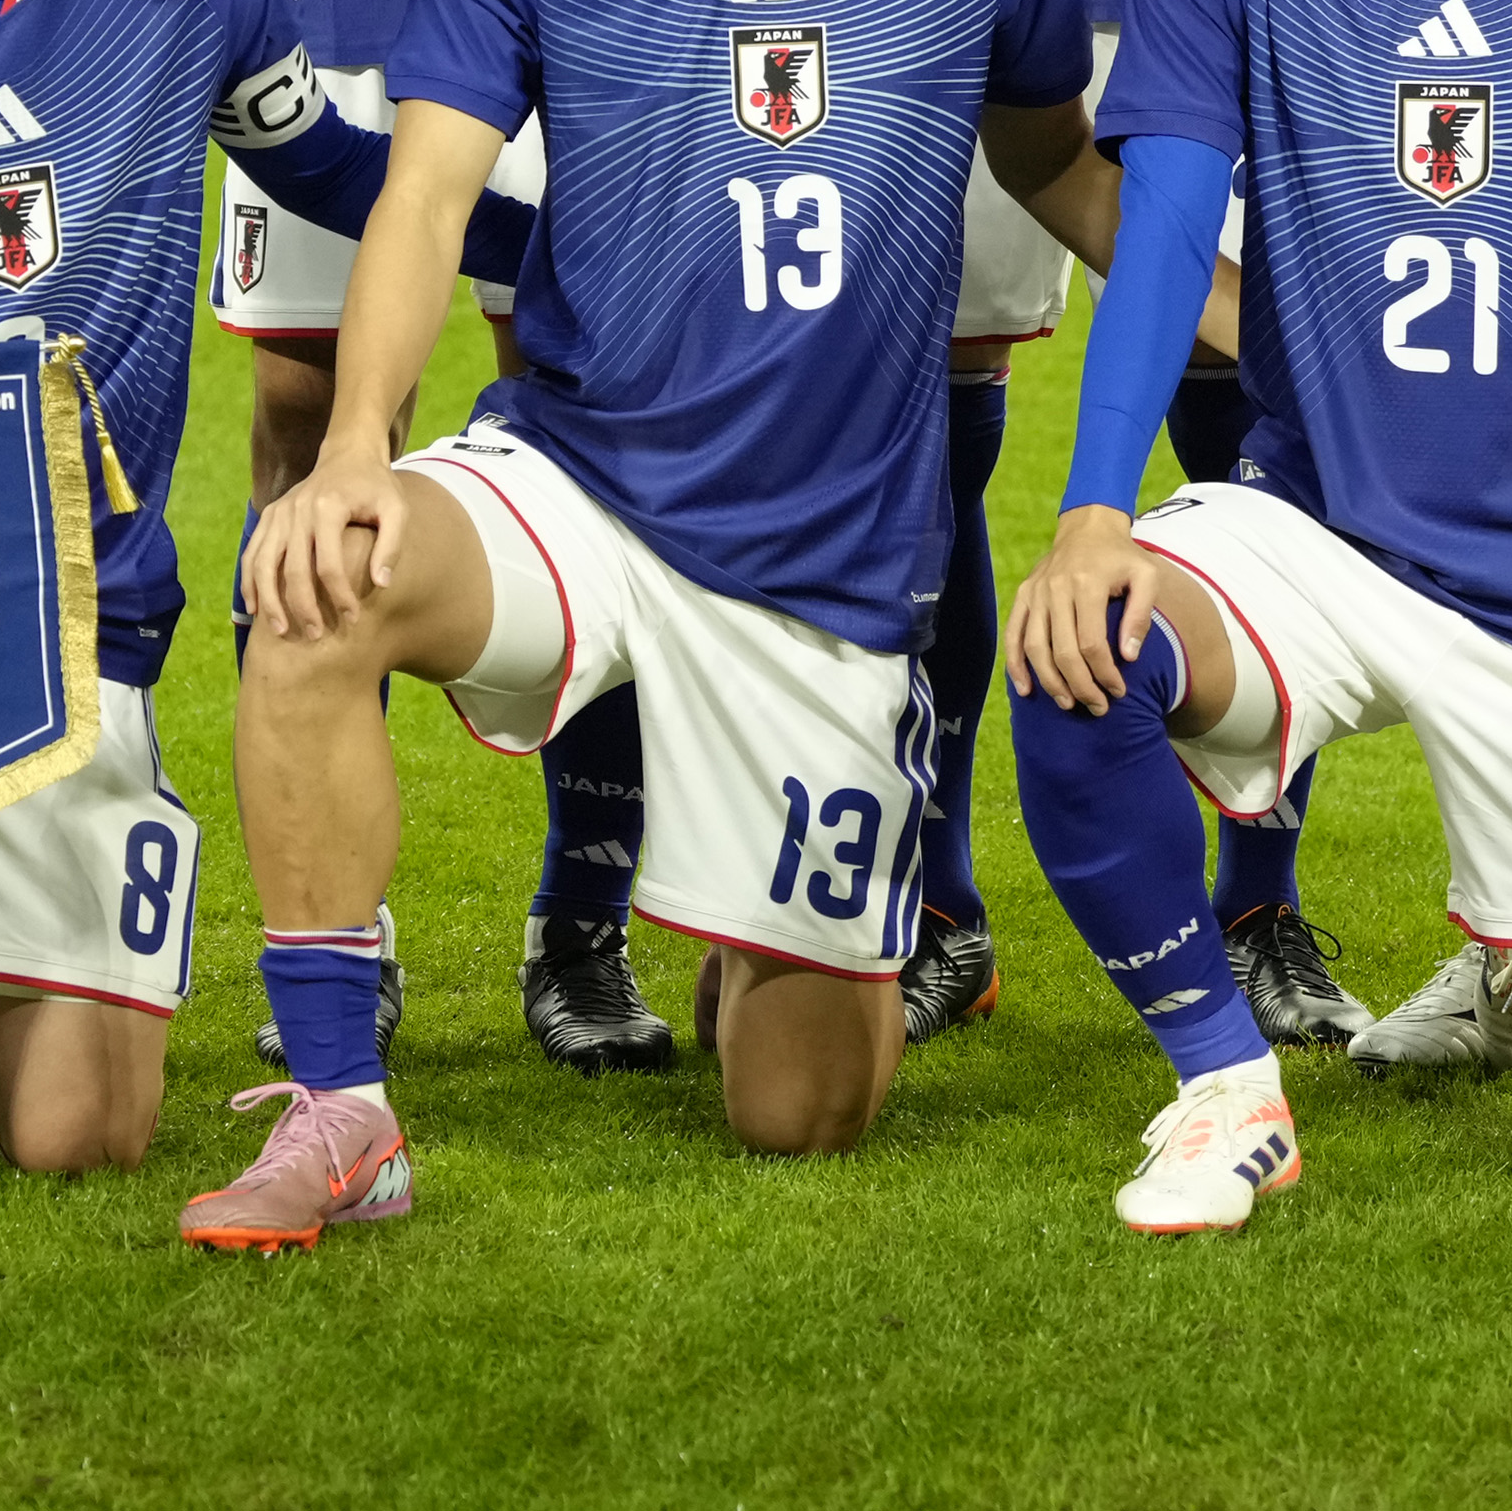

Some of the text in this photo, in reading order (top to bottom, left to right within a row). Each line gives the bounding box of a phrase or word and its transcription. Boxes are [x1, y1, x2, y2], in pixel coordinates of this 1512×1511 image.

[753, 30, 803, 42] JAPAN
[247, 75, 304, 132] C
[1420, 86, 1469, 98] JAPAN
[760, 107, 802, 126] JFA
[1421, 165, 1464, 183] JFA
[240, 206, 259, 216] JAPAN
[728, 174, 842, 312] 13
[1383, 235, 1499, 375] 21
[770, 775, 883, 920] 13
[120, 821, 178, 955] 8
